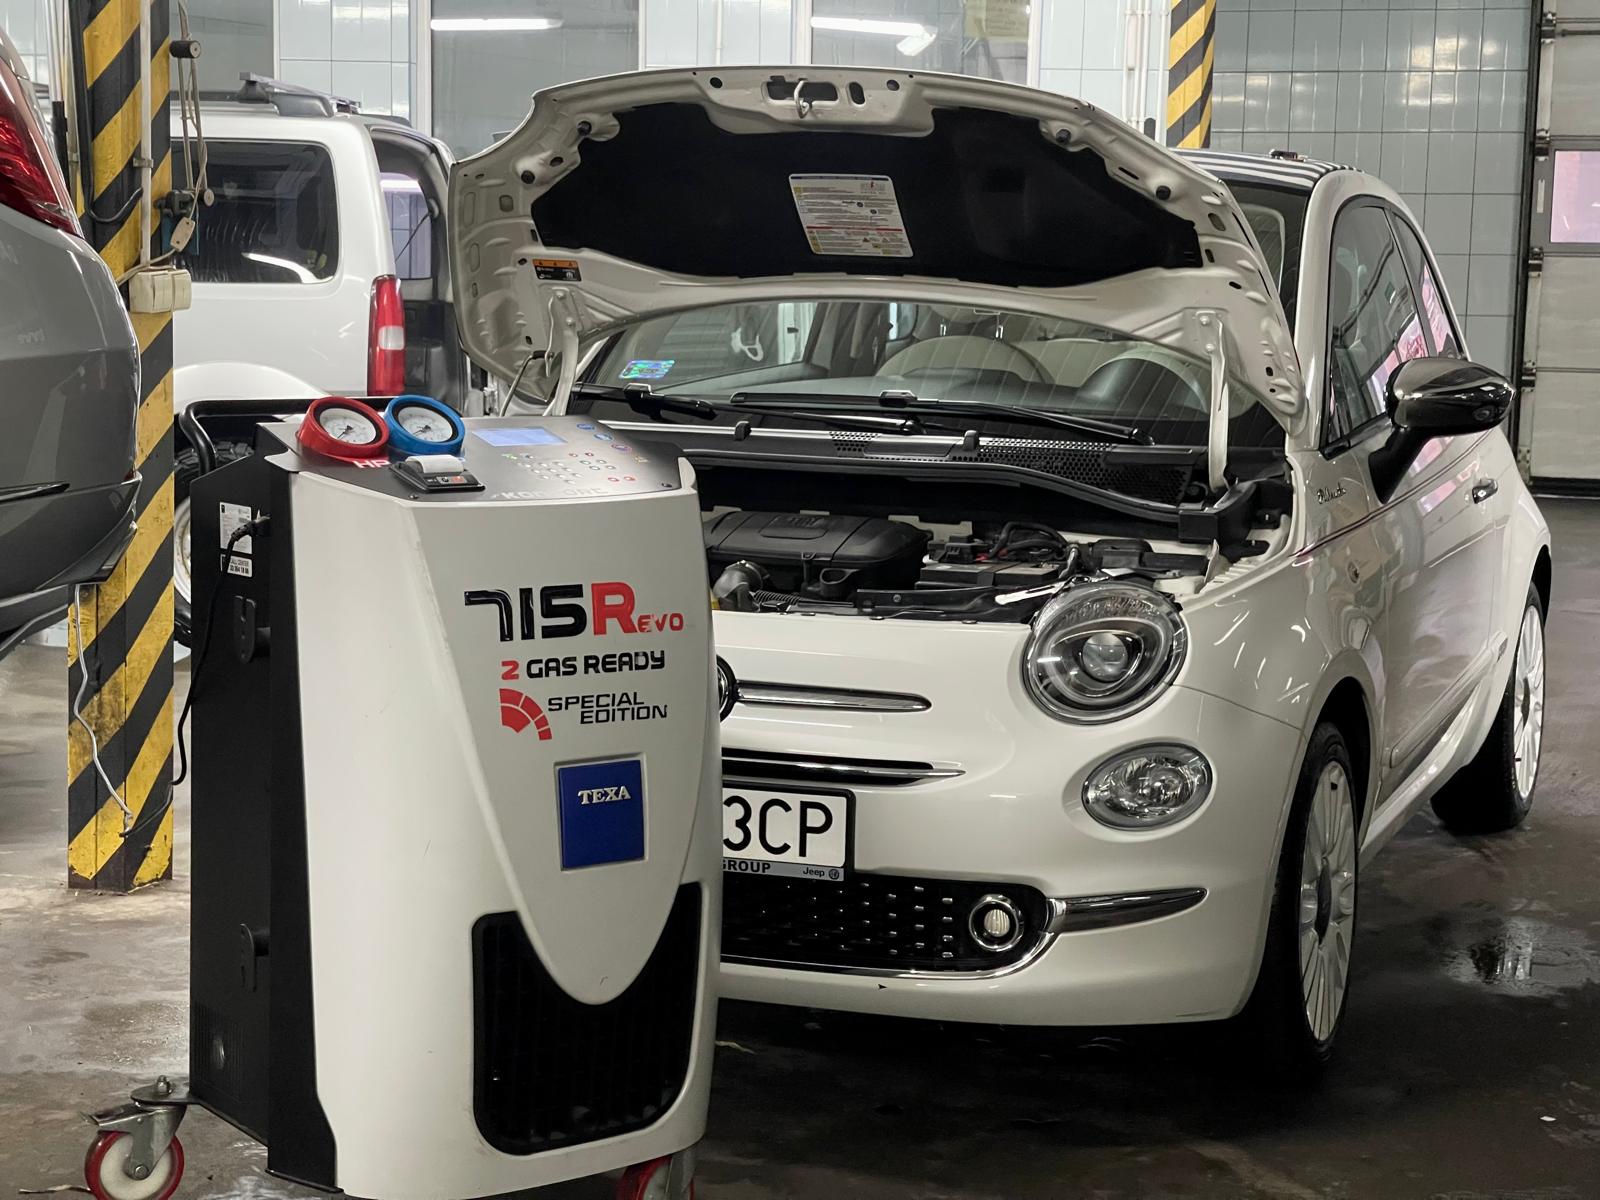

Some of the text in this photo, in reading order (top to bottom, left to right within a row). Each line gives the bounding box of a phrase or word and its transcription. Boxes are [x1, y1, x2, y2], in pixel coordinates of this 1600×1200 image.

[352, 460, 391, 469] HP
[501, 650, 666, 681] 2 GAS READY
[547, 691, 645, 712] SPECIAL
[580, 704, 668, 725] EDITION
[577, 785, 631, 805] TEXA
[802, 866, 825, 878] Jeep
